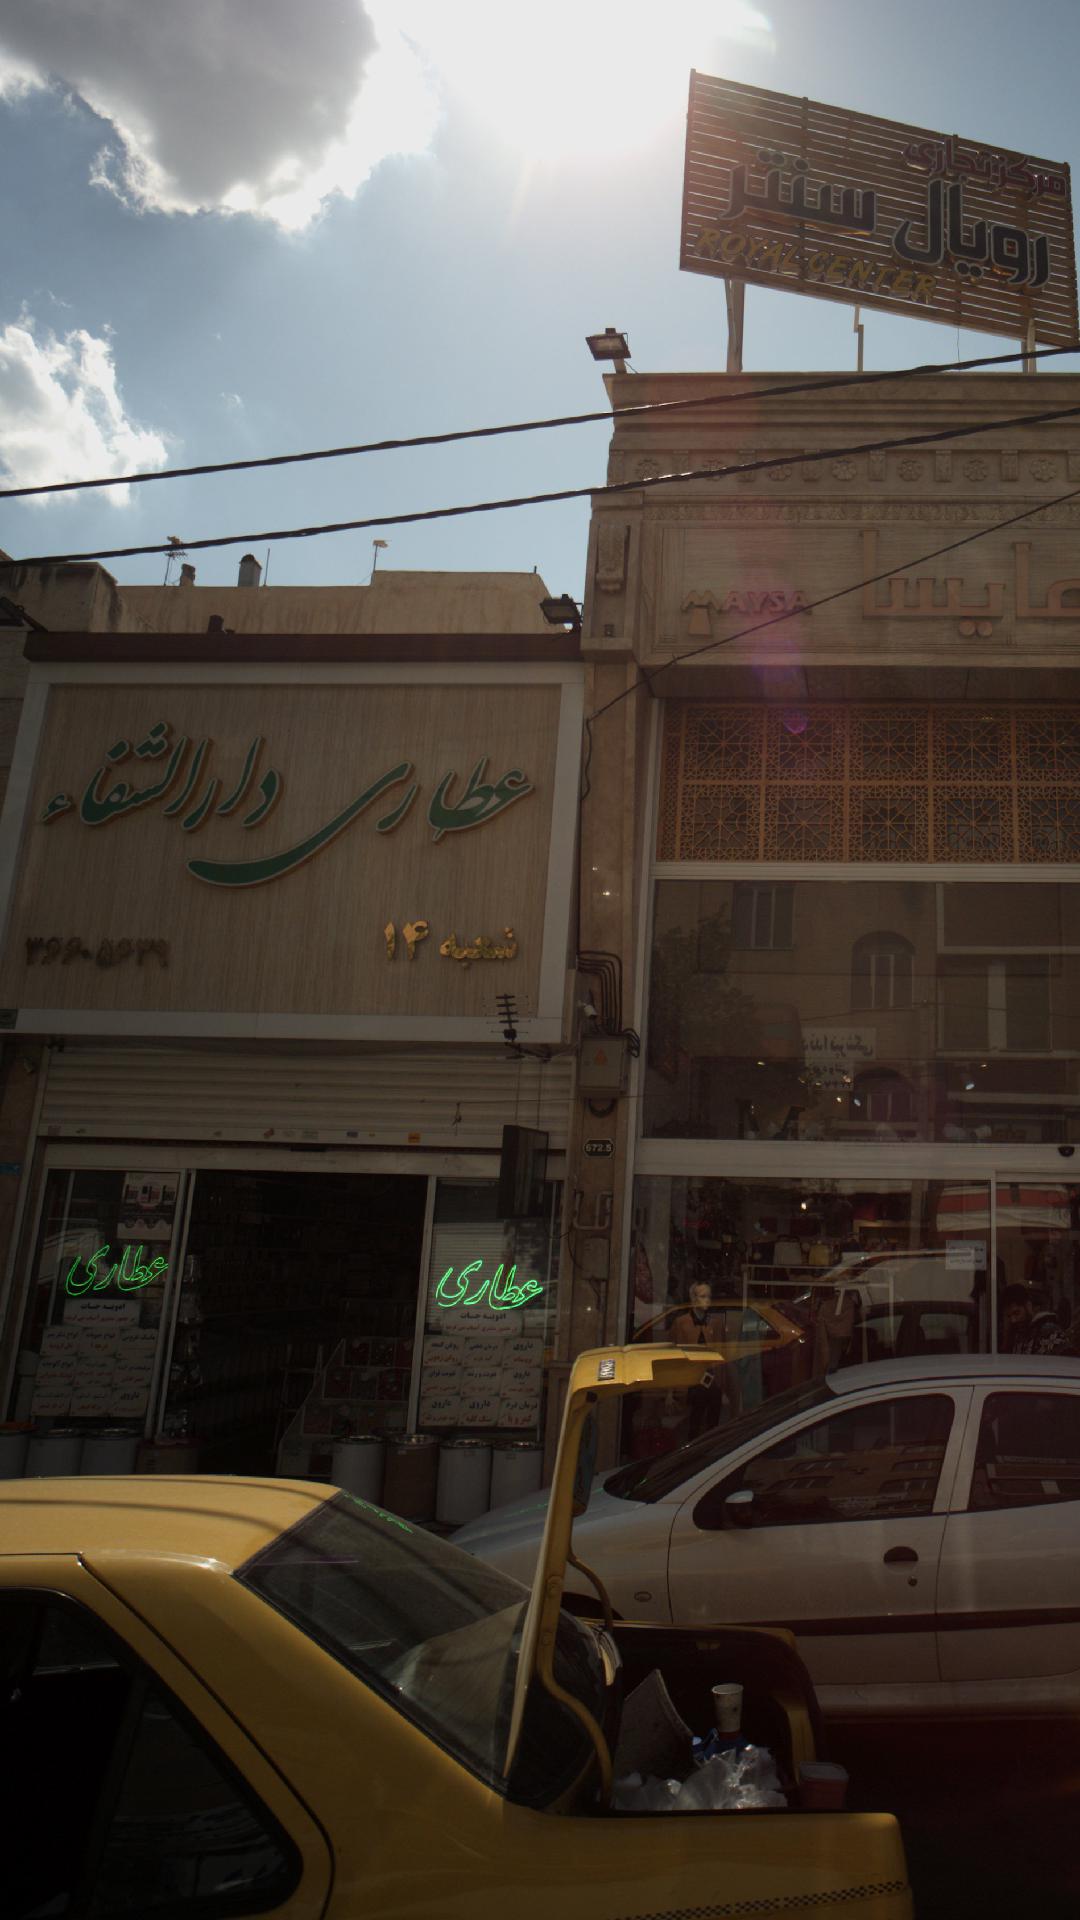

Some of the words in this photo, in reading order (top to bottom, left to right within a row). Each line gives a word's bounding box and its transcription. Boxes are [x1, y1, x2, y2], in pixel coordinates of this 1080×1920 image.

[903, 136, 994, 185] تجاری
[994, 155, 1067, 200] مرکز
[717, 148, 877, 233] سنتر
[891, 177, 1050, 288] رویال
[697, 227, 800, 275] ROYAL
[807, 250, 938, 300] CENTER
[186, 756, 534, 888] عطاری
[439, 927, 518, 970] شعبه
[65, 1244, 169, 1297] عطاری
[435, 1257, 544, 1311] عطاری
